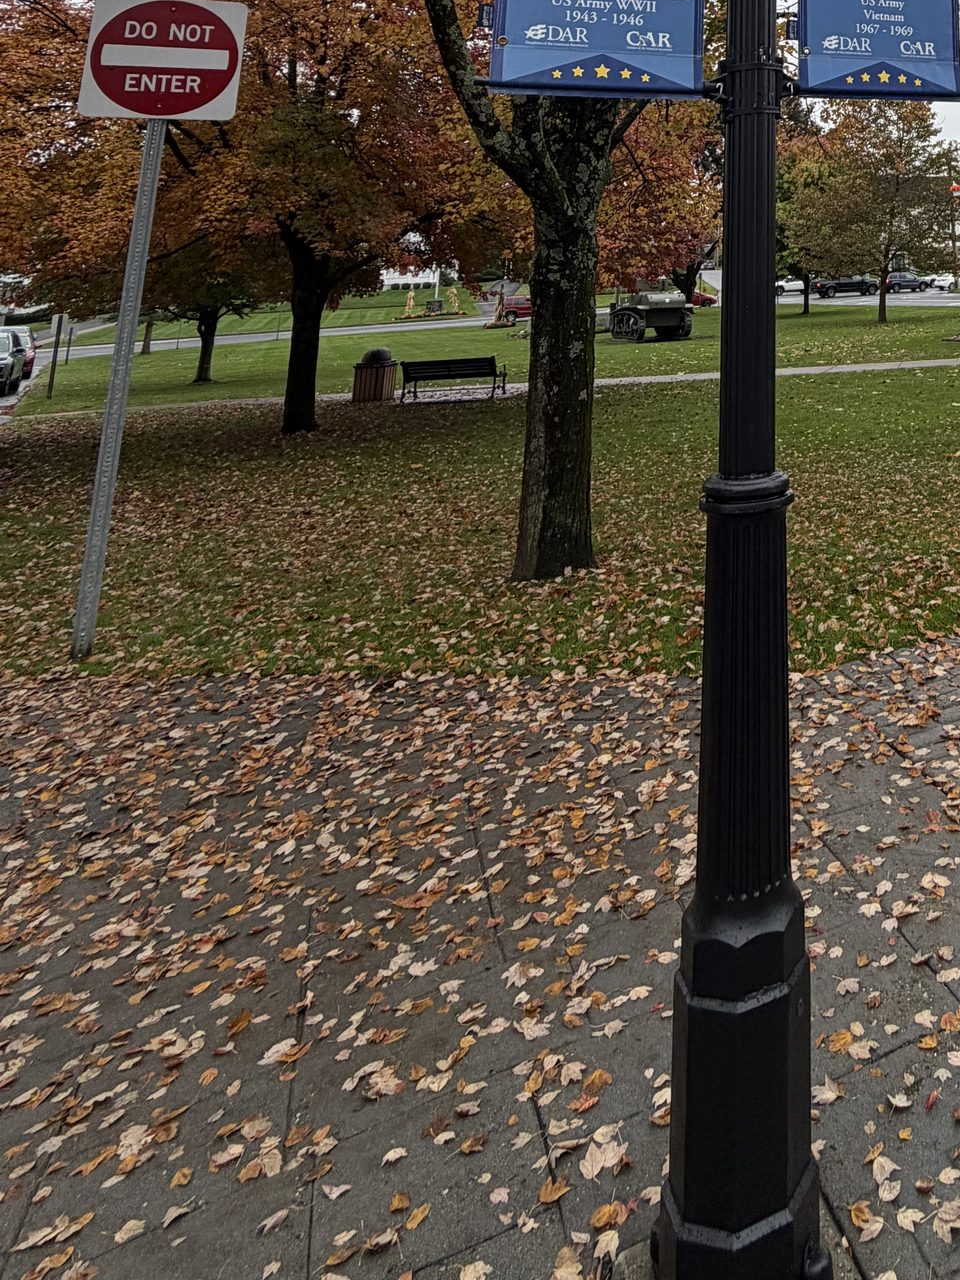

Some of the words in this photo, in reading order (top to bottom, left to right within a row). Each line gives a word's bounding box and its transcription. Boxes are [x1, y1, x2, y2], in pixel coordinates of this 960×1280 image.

[565, 10, 598, 23] 1943
[612, 13, 644, 26] 1946
[863, 9, 905, 22] Vietnam
[124, 20, 157, 40] DO
[168, 23, 215, 43] NOT
[548, 25, 589, 43] DAR
[856, 23, 880, 34] 1967
[890, 25, 914, 37] 1969
[839, 36, 872, 52] DAR
[124, 73, 201, 94] ENTER
